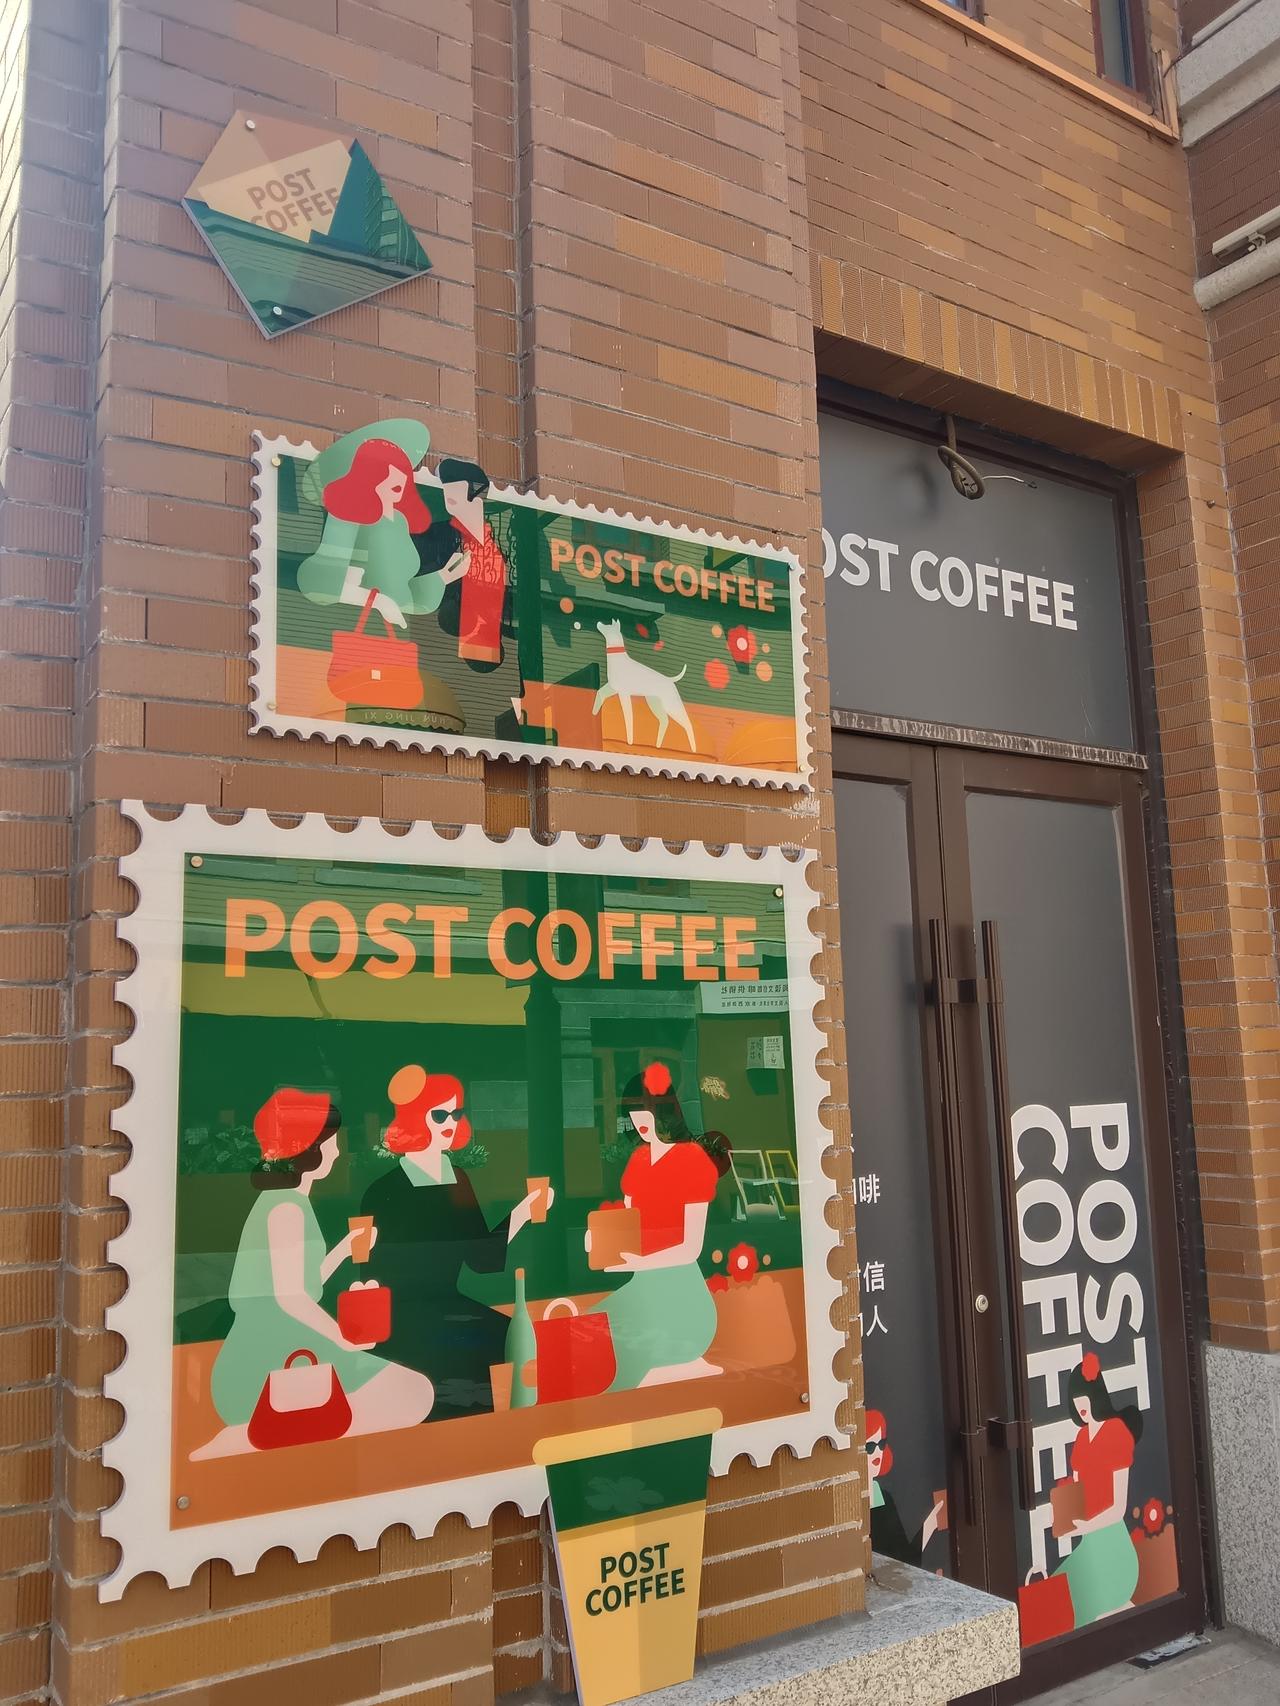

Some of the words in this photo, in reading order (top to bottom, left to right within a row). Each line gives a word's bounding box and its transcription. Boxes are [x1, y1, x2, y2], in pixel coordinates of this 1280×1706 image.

[246, 168, 316, 211] POST
[550, 537, 646, 587] POST
[653, 560, 776, 613] COFFEE
[910, 550, 1078, 631] COFFEE
[224, 897, 469, 979] POST
[487, 907, 760, 981] COFFEE
[852, 1173, 881, 1205] 啡
[857, 1260, 885, 1293] 信
[1069, 1102, 1151, 1411] POST
[859, 1304, 889, 1338] 人
[600, 1542, 670, 1584] POST
[585, 1568, 685, 1617] COFFEE
